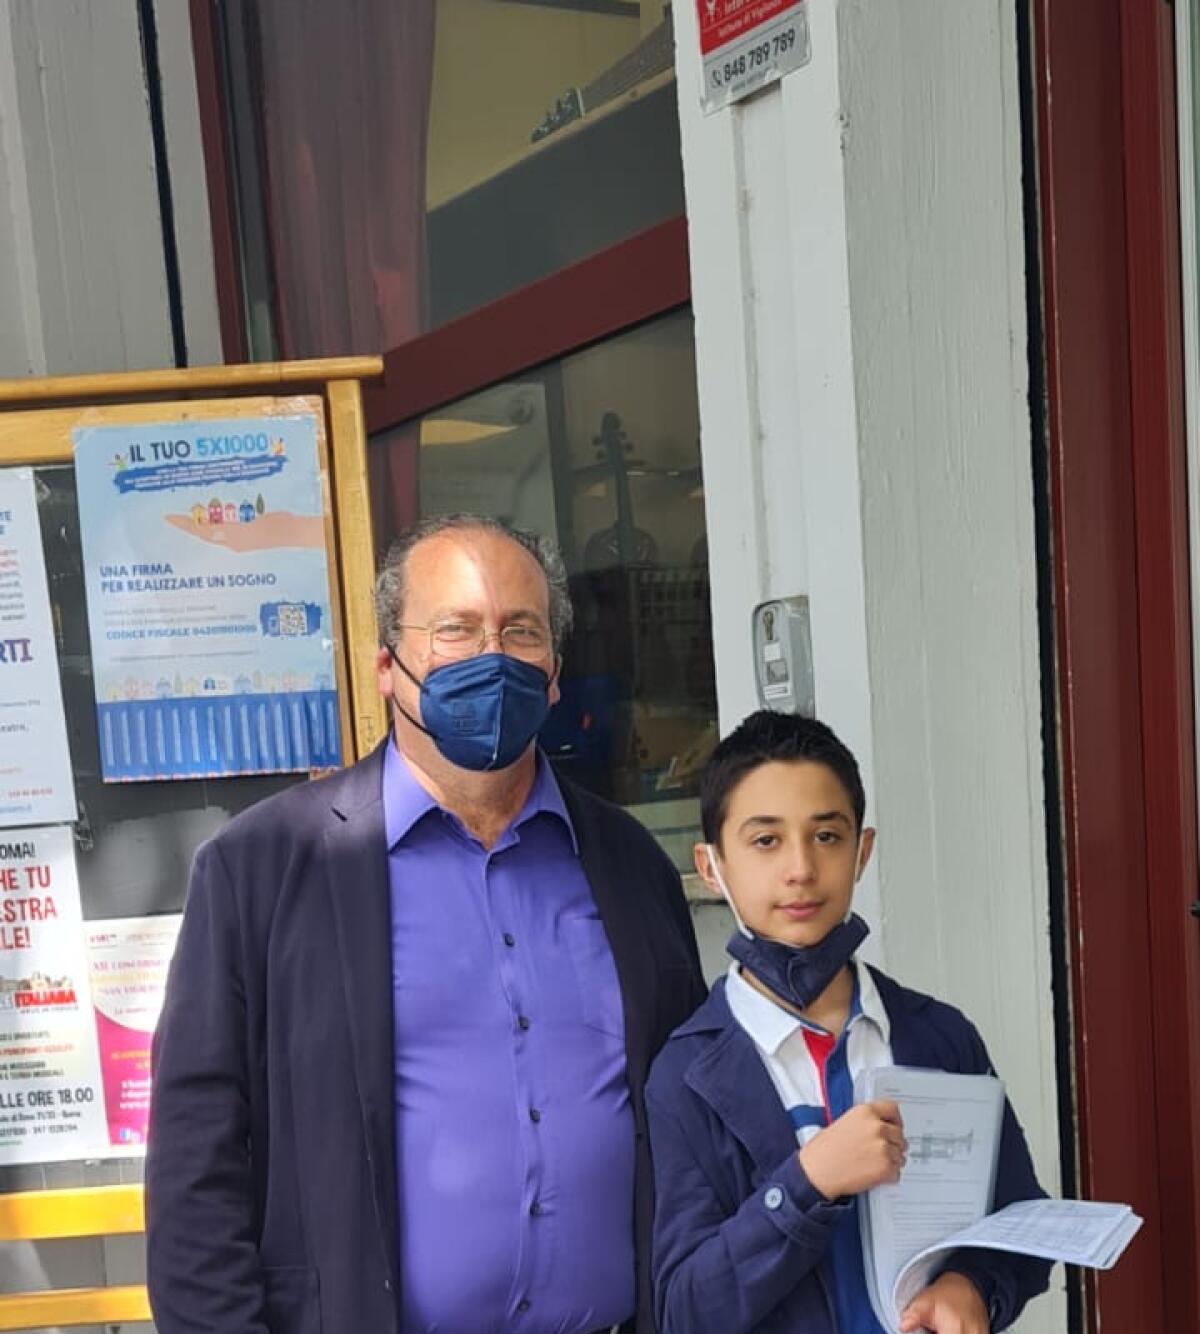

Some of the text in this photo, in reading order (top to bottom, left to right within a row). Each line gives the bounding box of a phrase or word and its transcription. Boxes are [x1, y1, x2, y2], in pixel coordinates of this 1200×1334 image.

[724, 55, 746, 82] 848
[748, 42, 771, 69] 789
[773, 28, 796, 56] 789
[130, 432, 269, 463] IL TUO 5X1000
[100, 563, 174, 578] UNA FIRMA
[101, 573, 276, 594] PER REALIZZARE UN SOGNO
[148, 627, 189, 638] FISCALE
[25, 864, 52, 890] TU
[27, 1089, 56, 1108] ORE
